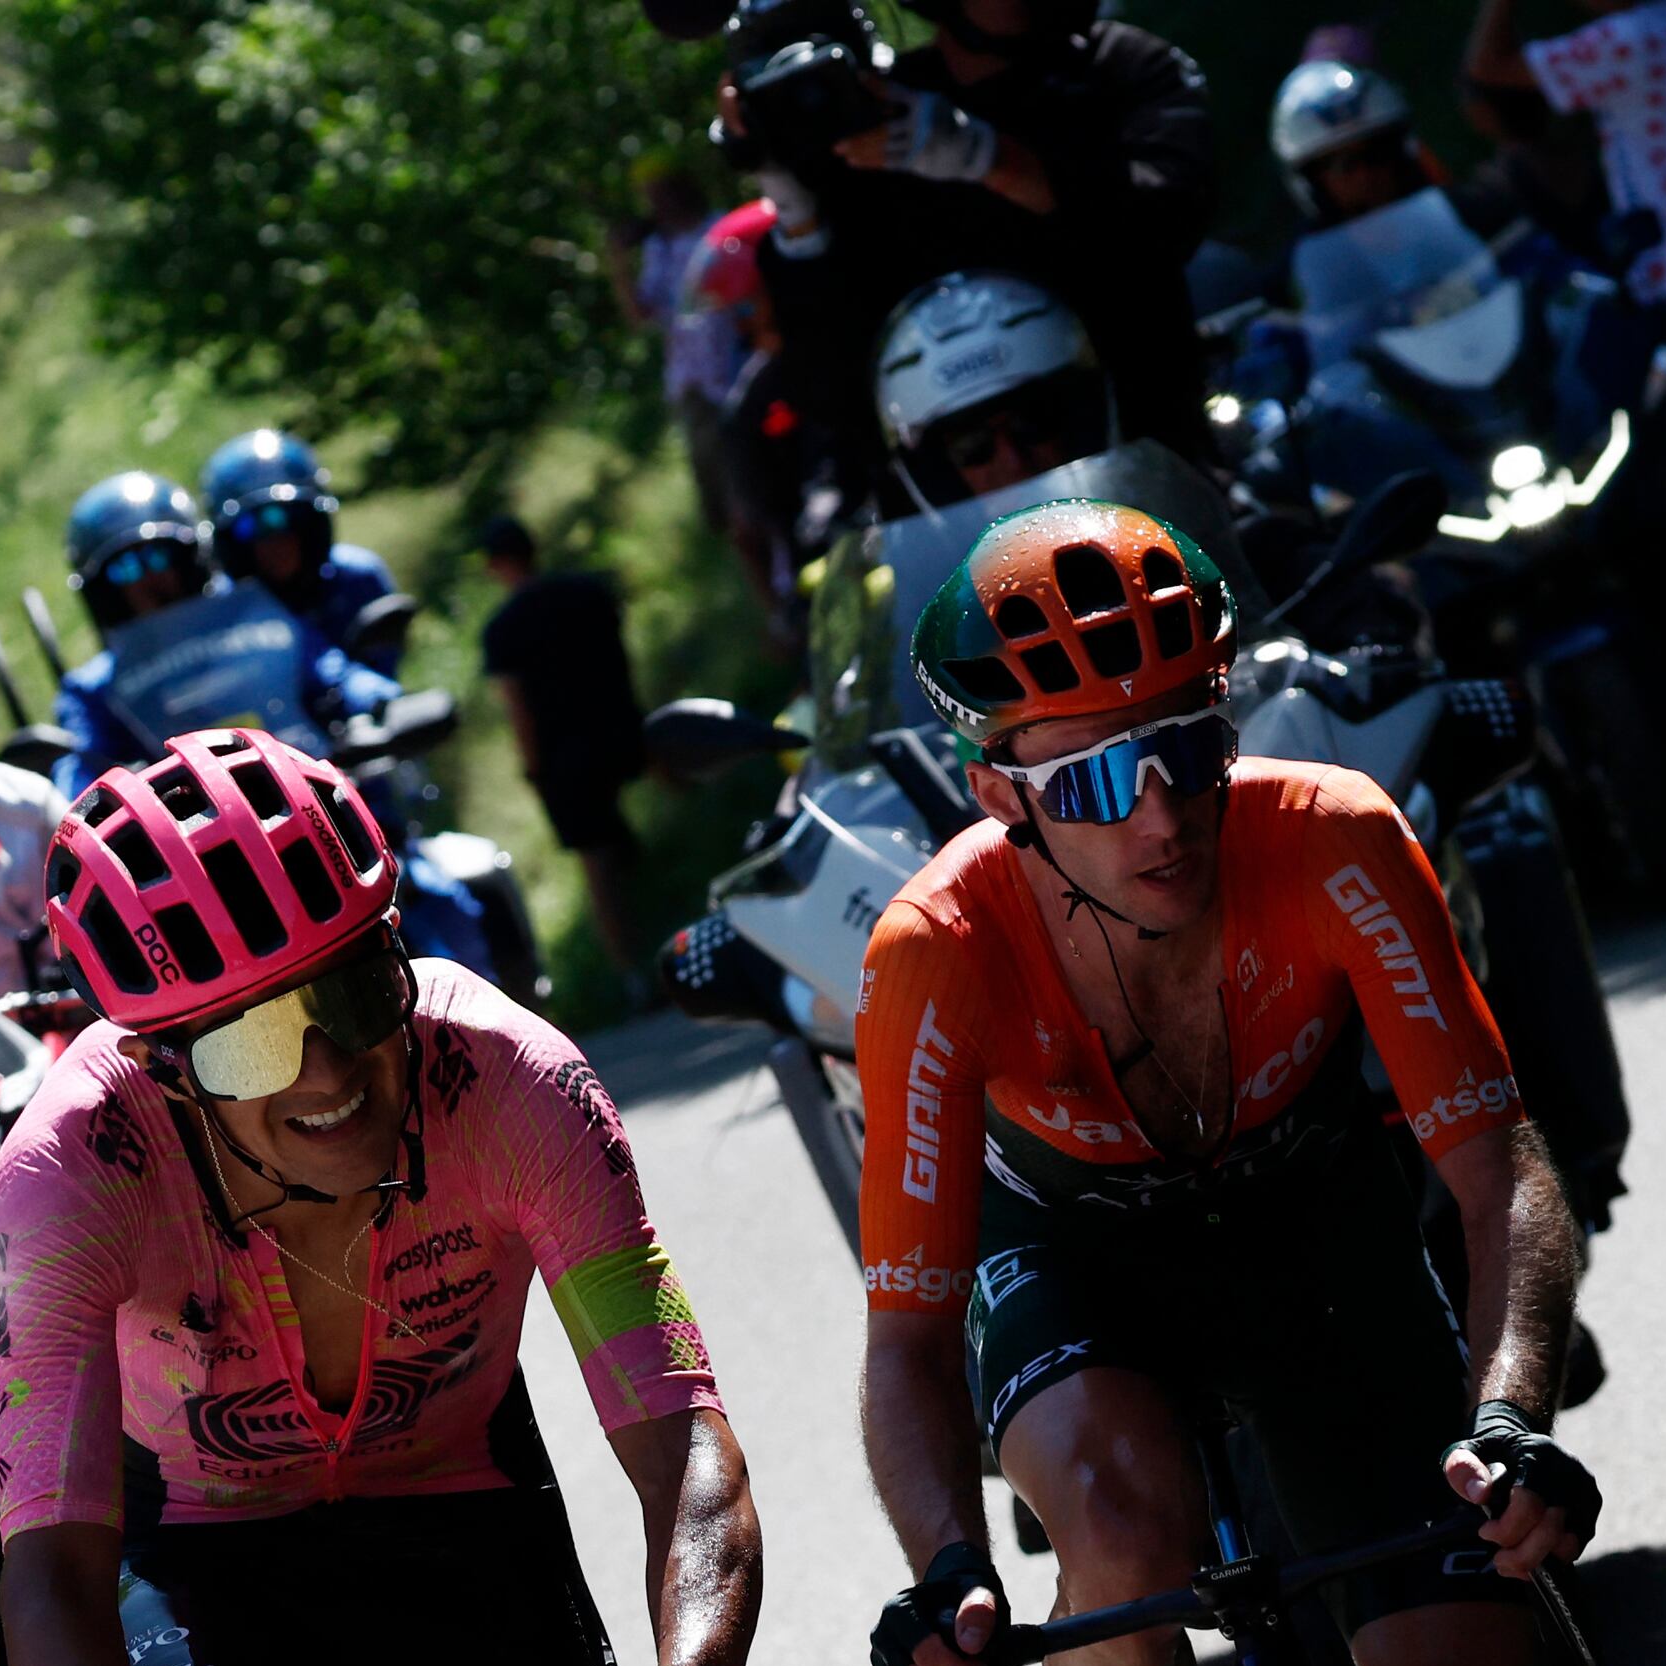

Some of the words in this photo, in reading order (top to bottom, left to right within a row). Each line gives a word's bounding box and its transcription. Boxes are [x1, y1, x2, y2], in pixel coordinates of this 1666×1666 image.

[916, 660, 988, 727] GIANT
[1323, 862, 1450, 1032] GIANT
[901, 997, 956, 1206] GIANT
[399, 1269, 493, 1313] wahoo
[863, 1258, 975, 1304] etsgo
[988, 1338, 1094, 1436] DEX
[1210, 1563, 1252, 1582] GARMIN
